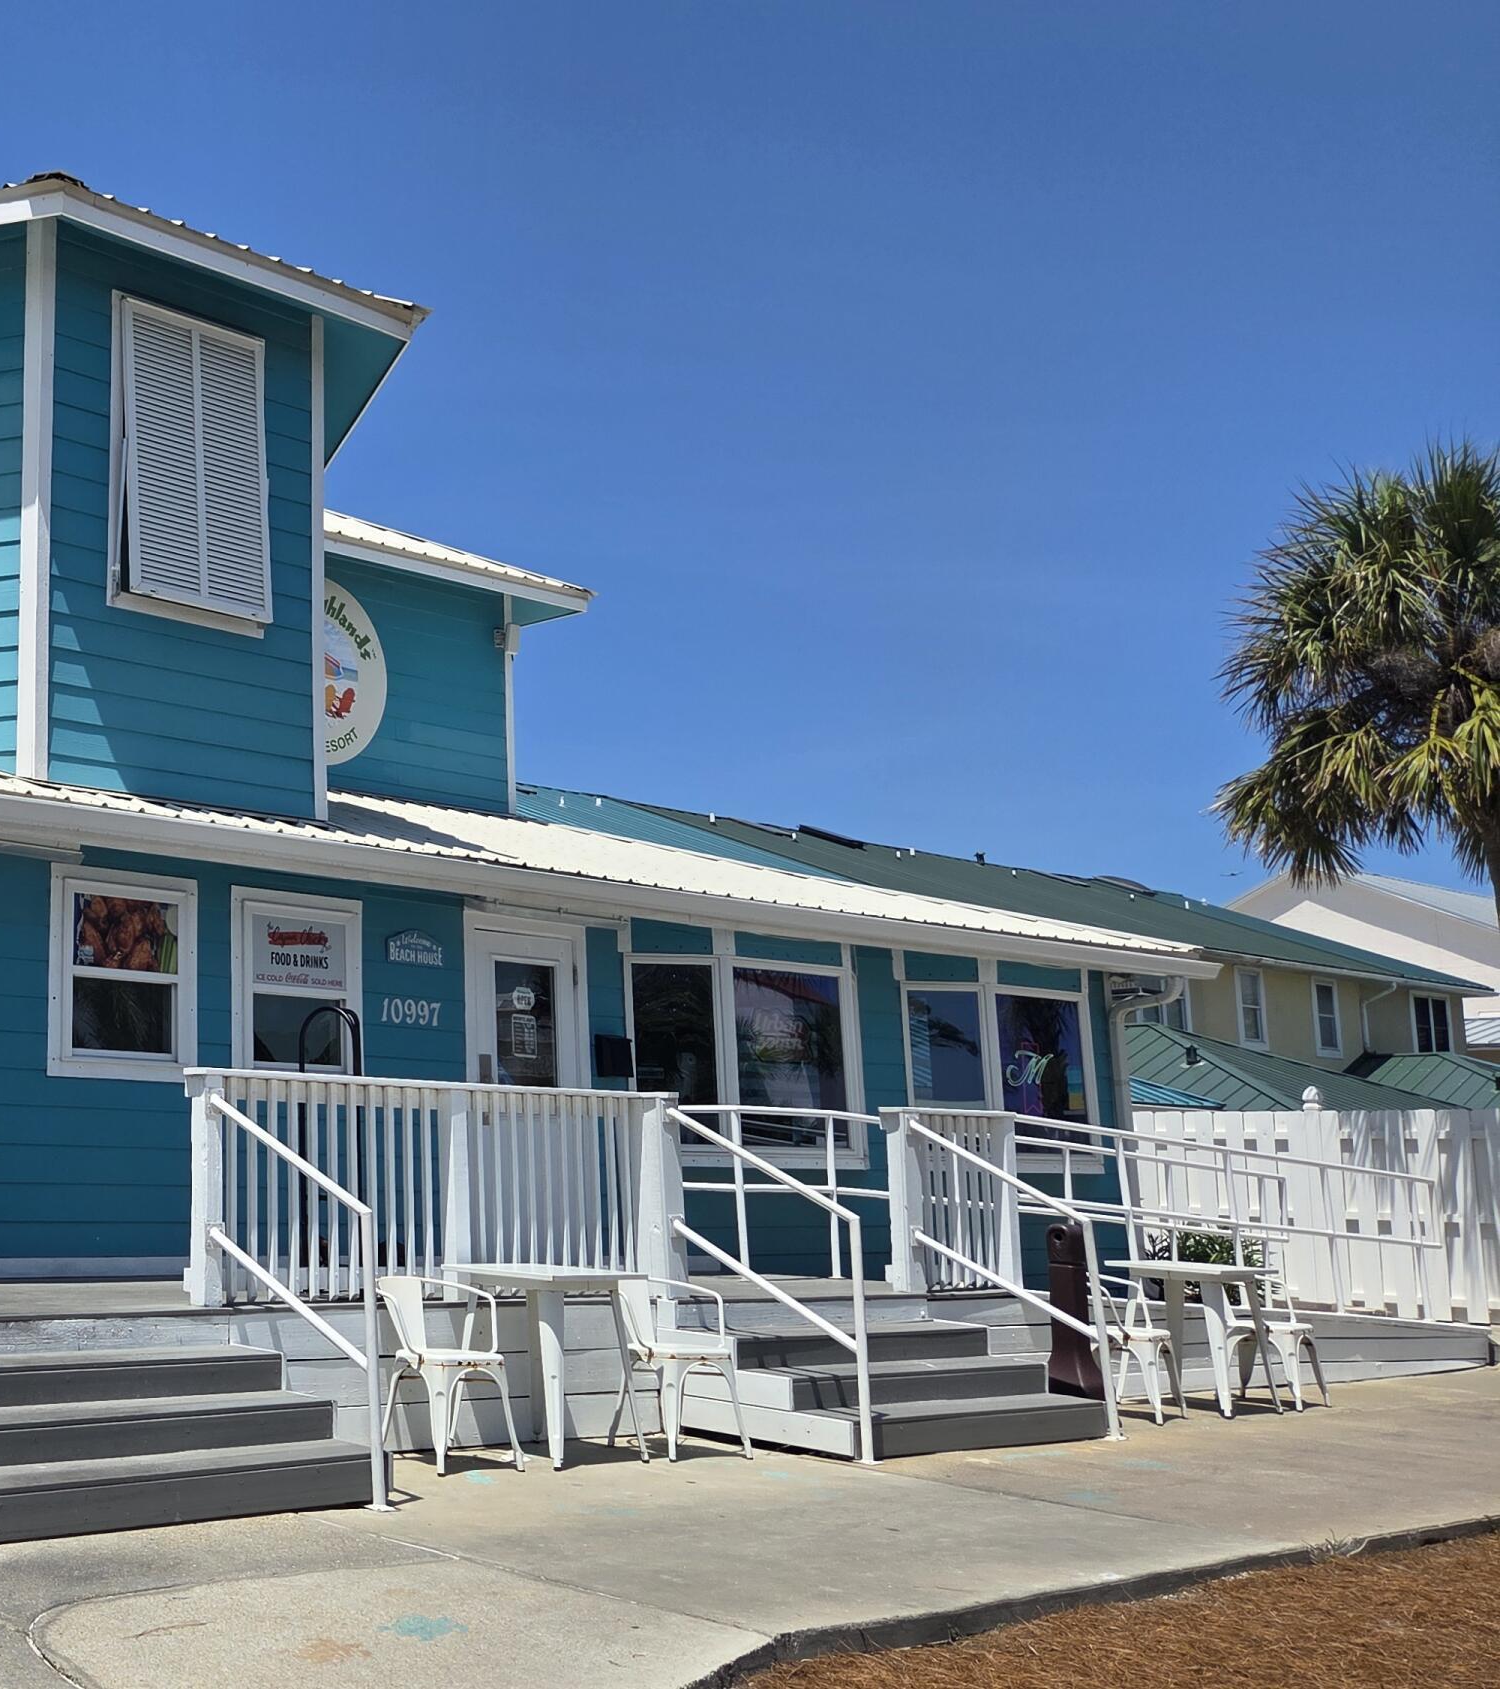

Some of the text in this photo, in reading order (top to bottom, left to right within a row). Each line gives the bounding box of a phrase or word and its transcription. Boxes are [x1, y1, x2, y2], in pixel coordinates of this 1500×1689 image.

[324, 596, 371, 661] hlands
[325, 727, 359, 753] ESORT
[270, 951, 329, 970] FOOD & DRINKS
[389, 941, 443, 966] BEACH HOUSE
[256, 973, 266, 981] ICE
[266, 974, 284, 982] COLD
[311, 977, 327, 986] SOLD
[328, 979, 343, 987] HERE
[381, 998, 441, 1027] 10997
